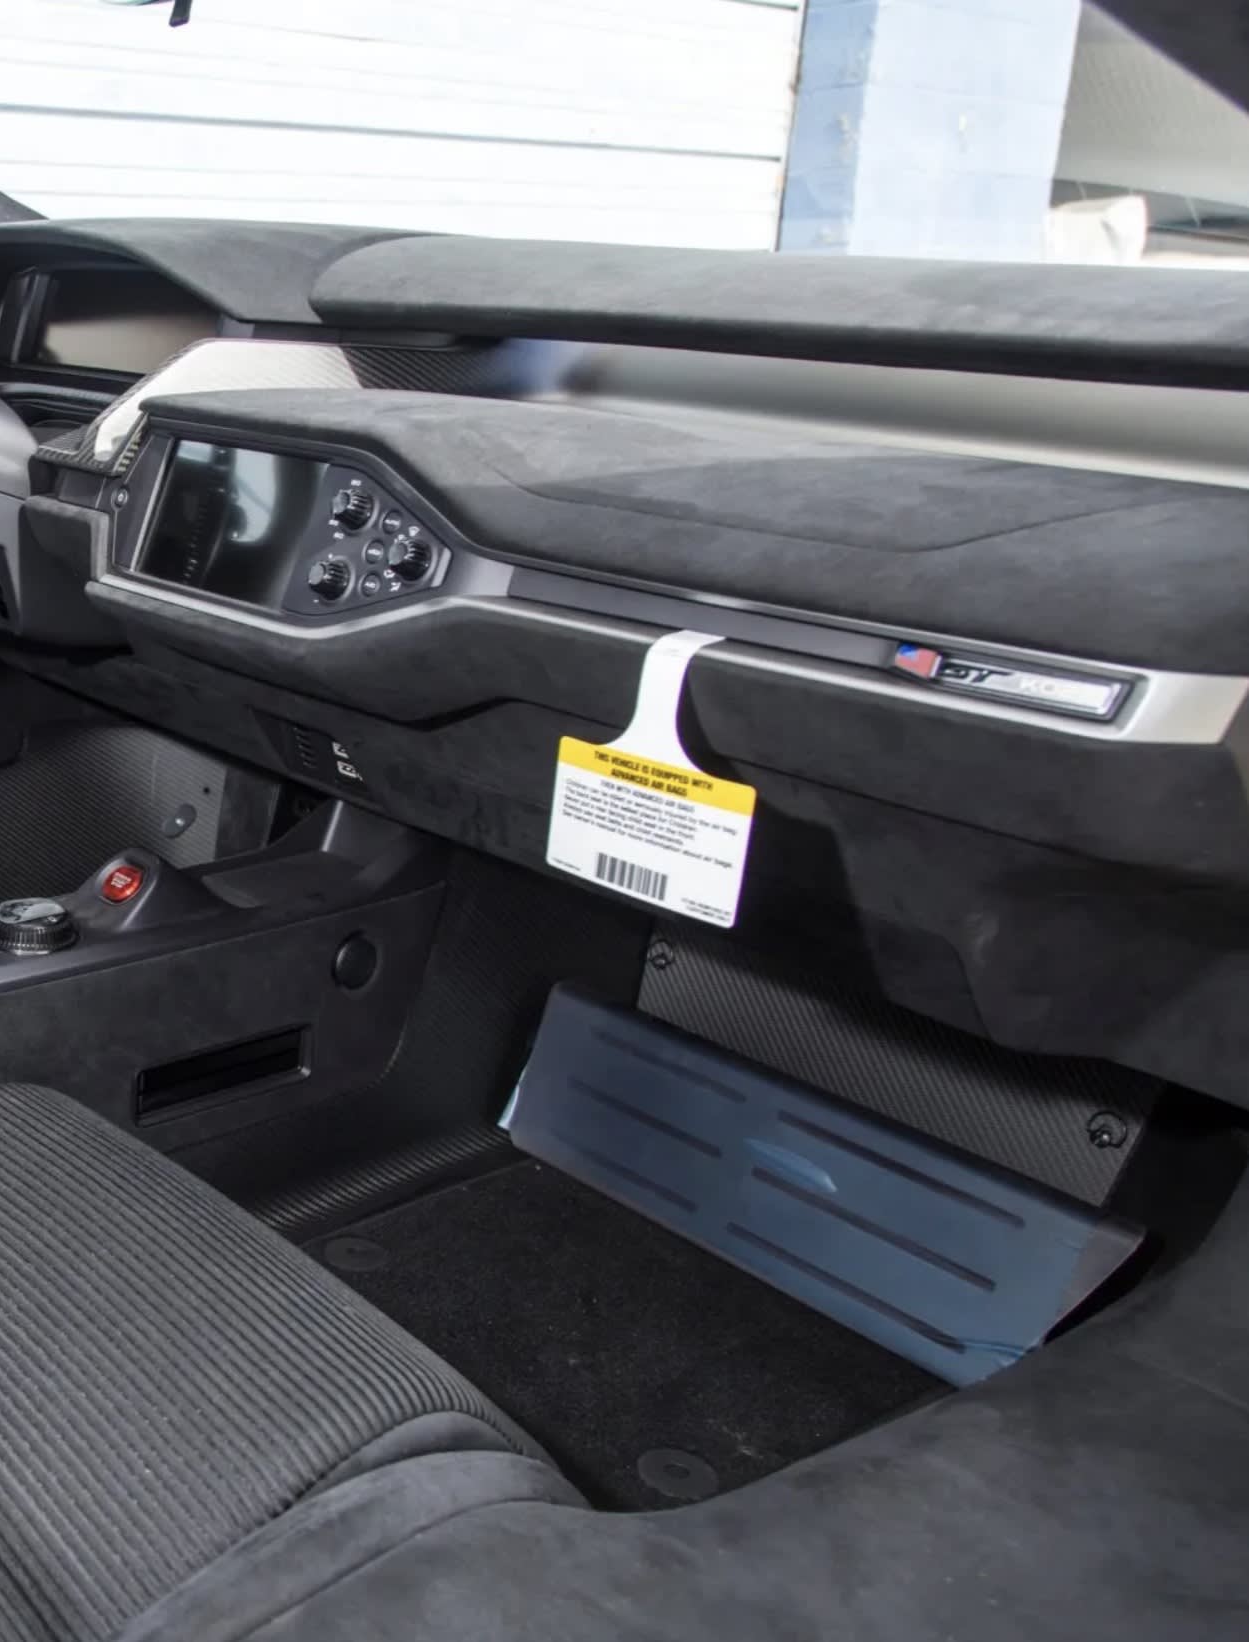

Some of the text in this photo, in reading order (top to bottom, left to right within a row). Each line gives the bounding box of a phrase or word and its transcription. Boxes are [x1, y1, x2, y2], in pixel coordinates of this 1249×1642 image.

[943, 662, 1012, 682] GT
[611, 755, 640, 770] VEHICLE
[641, 764, 649, 773] IS
[691, 777, 713, 791] WITH
[611, 768, 688, 797] ADVANCED AIR BAGS
